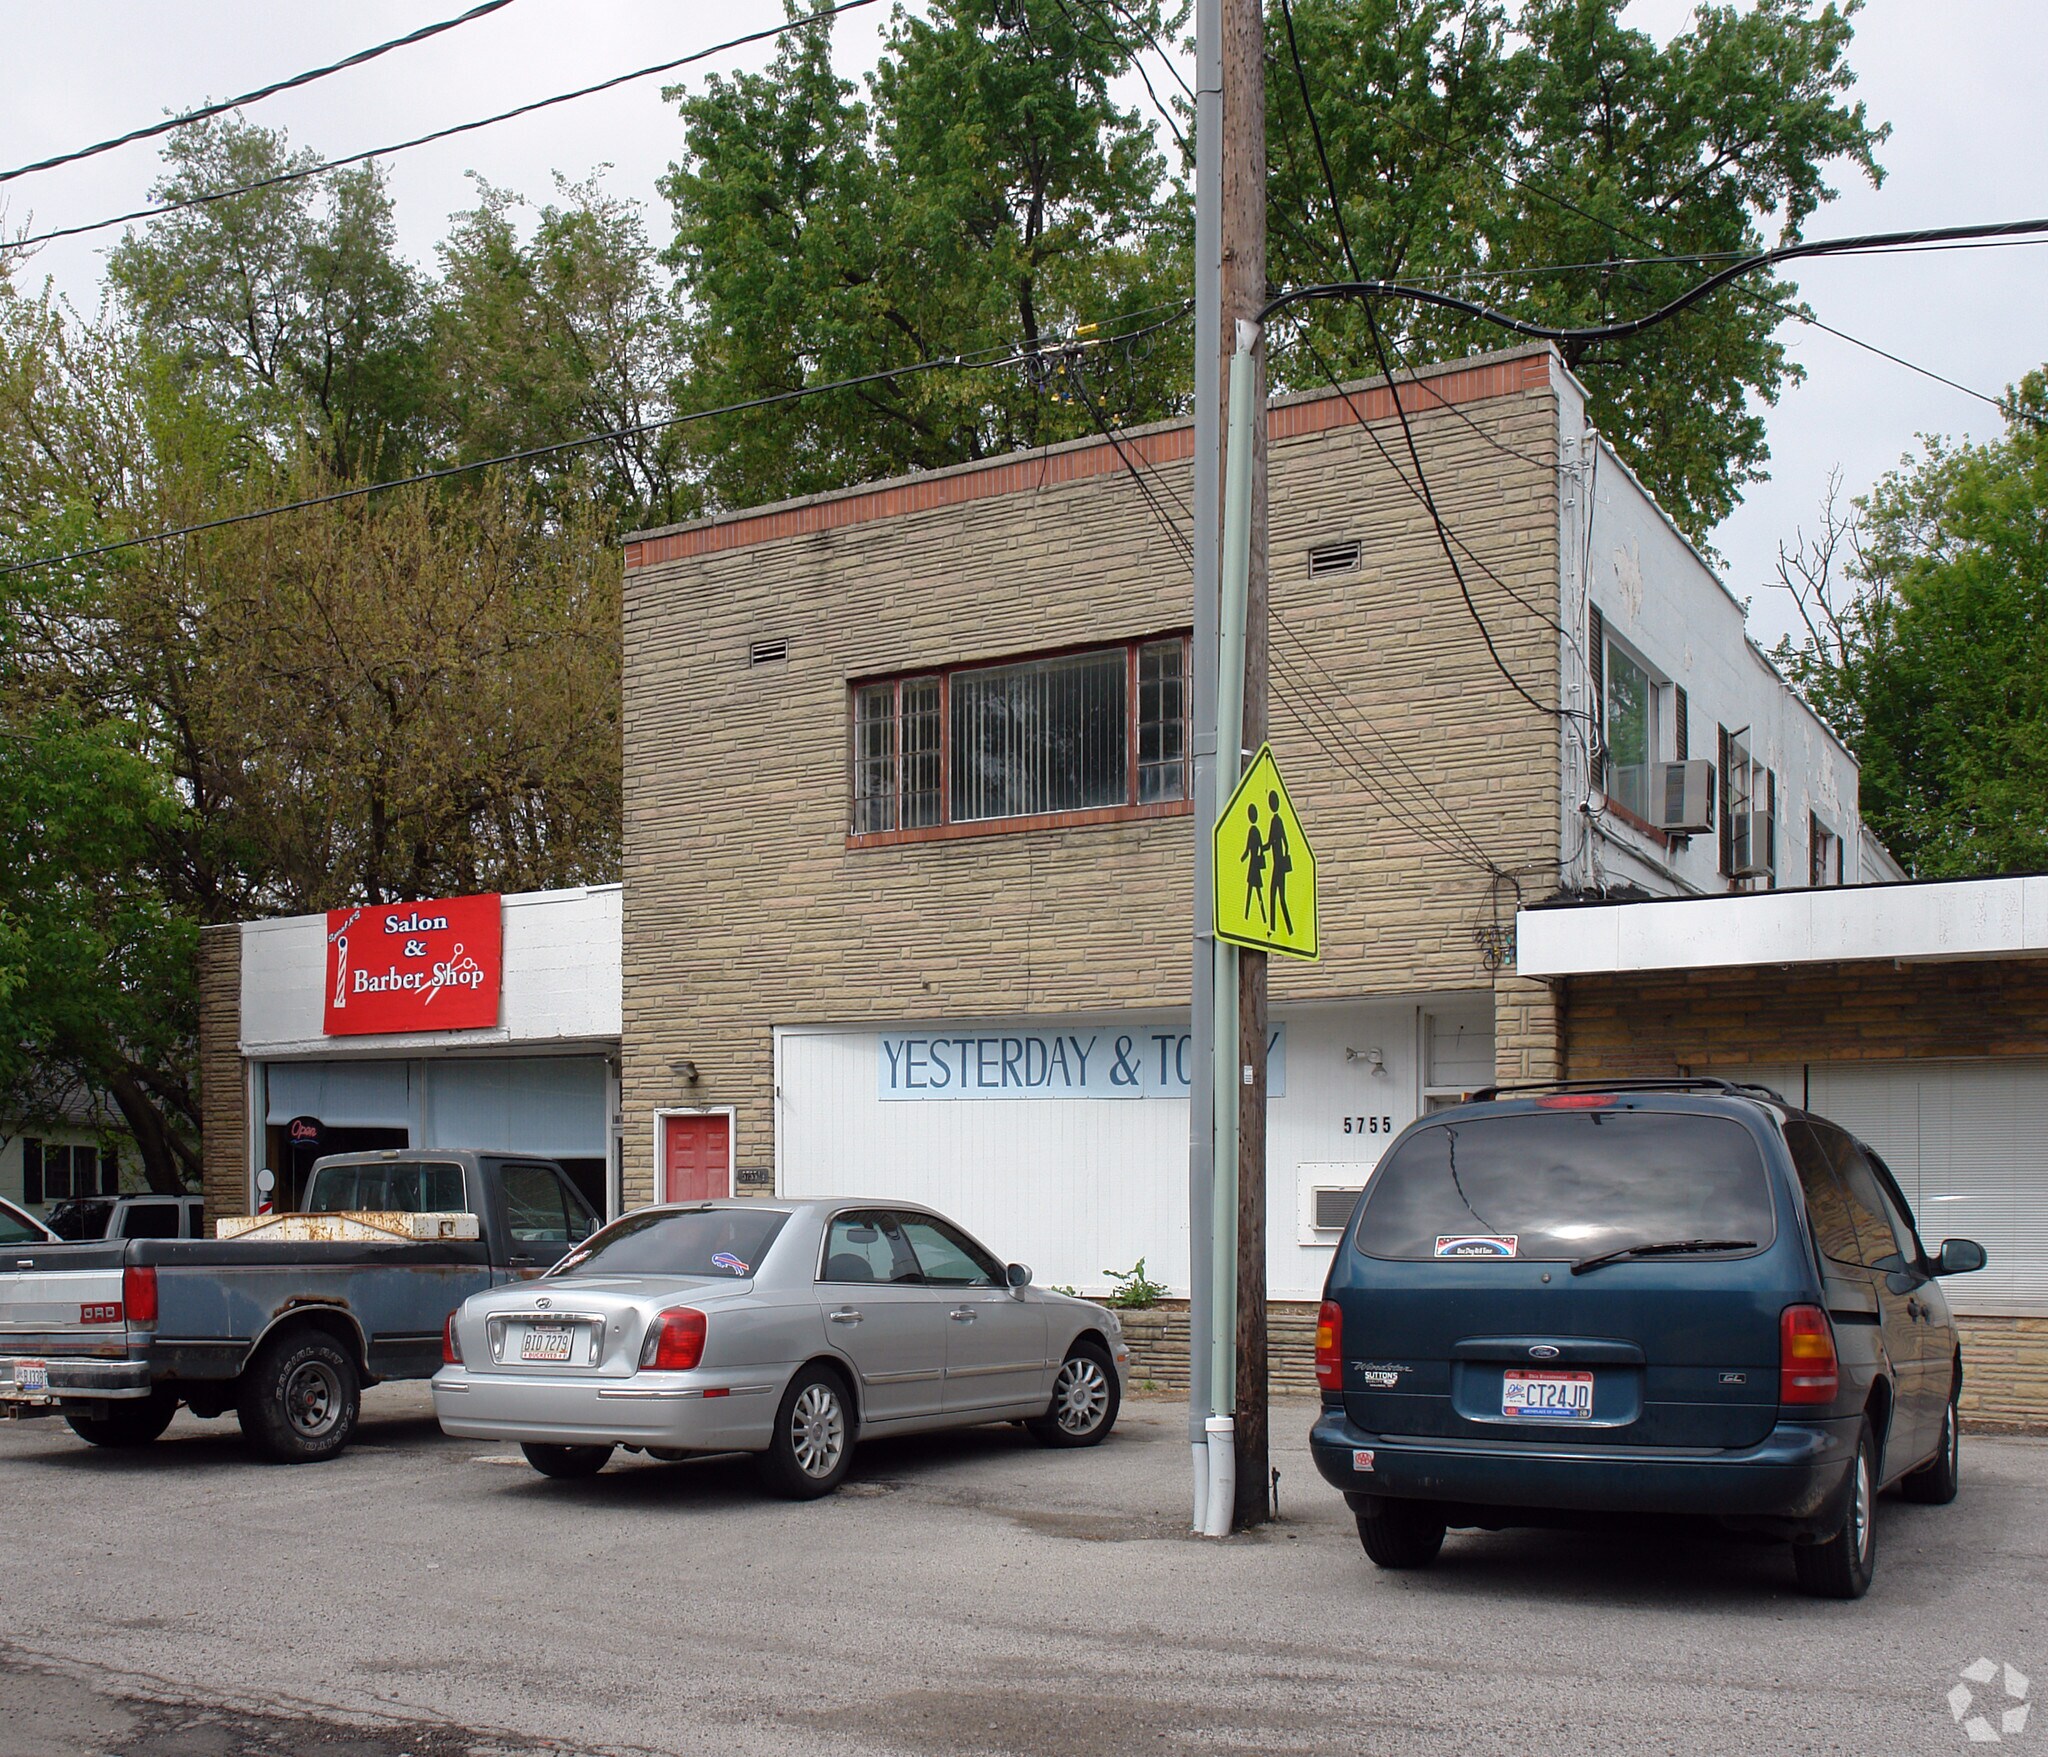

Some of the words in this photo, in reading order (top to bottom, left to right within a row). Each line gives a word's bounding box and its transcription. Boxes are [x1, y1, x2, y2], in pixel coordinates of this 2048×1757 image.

[384, 911, 449, 934] Salon
[403, 938, 428, 957] &
[352, 965, 425, 993] Barber
[430, 961, 485, 990] Shop
[882, 1034, 1098, 1089] YESTERDAY
[1108, 1034, 1142, 1086] &
[291, 1120, 317, 1139] Open
[1343, 1116, 1392, 1134] 5755
[544, 1335, 569, 1352] 7279
[1350, 1361, 1413, 1372] Windstar
[1526, 1383, 1589, 1408] CT24JD
